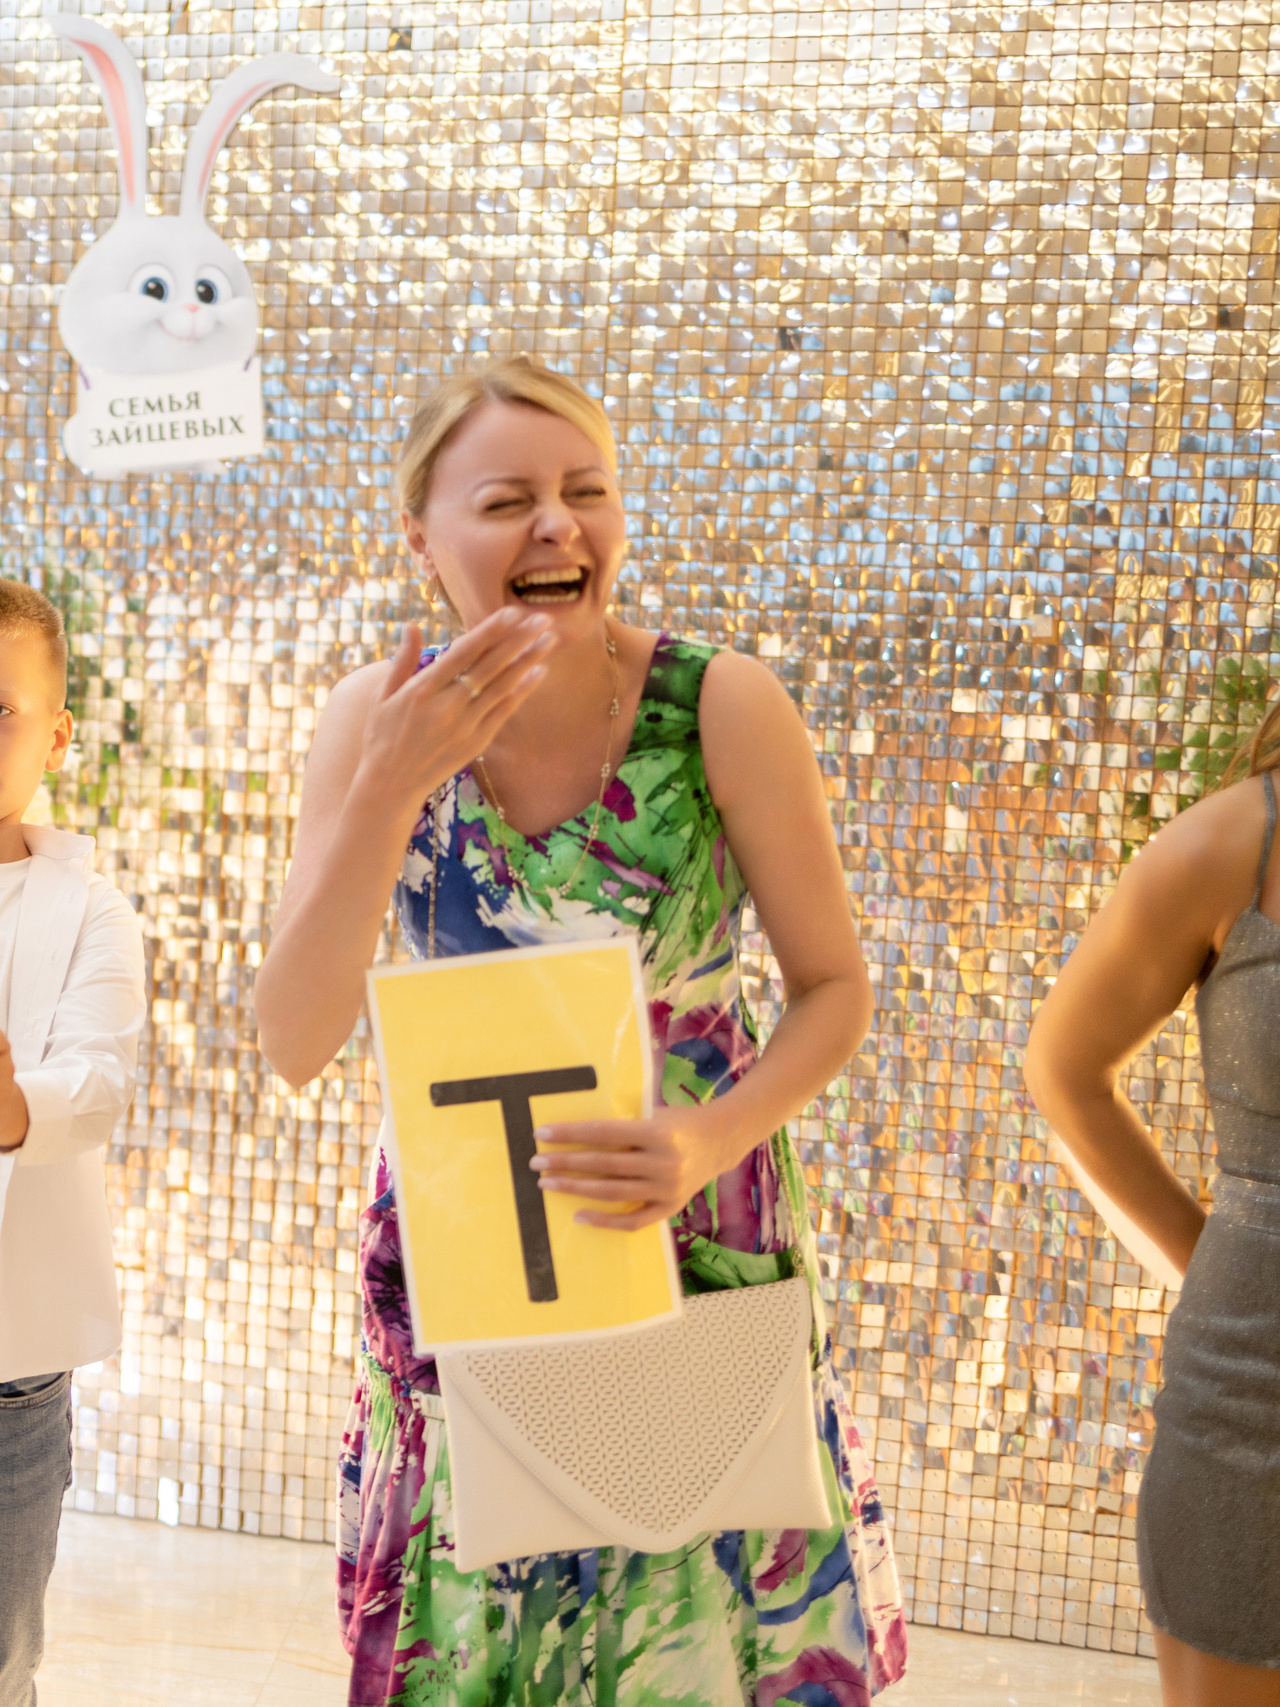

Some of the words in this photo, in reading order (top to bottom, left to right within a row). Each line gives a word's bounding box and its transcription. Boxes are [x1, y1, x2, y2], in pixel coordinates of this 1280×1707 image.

[108, 391, 201, 418] СЕМЬЯ
[90, 416, 244, 447] ЗАЙЦЕВЫХ
[429, 1065, 597, 1303] Т
